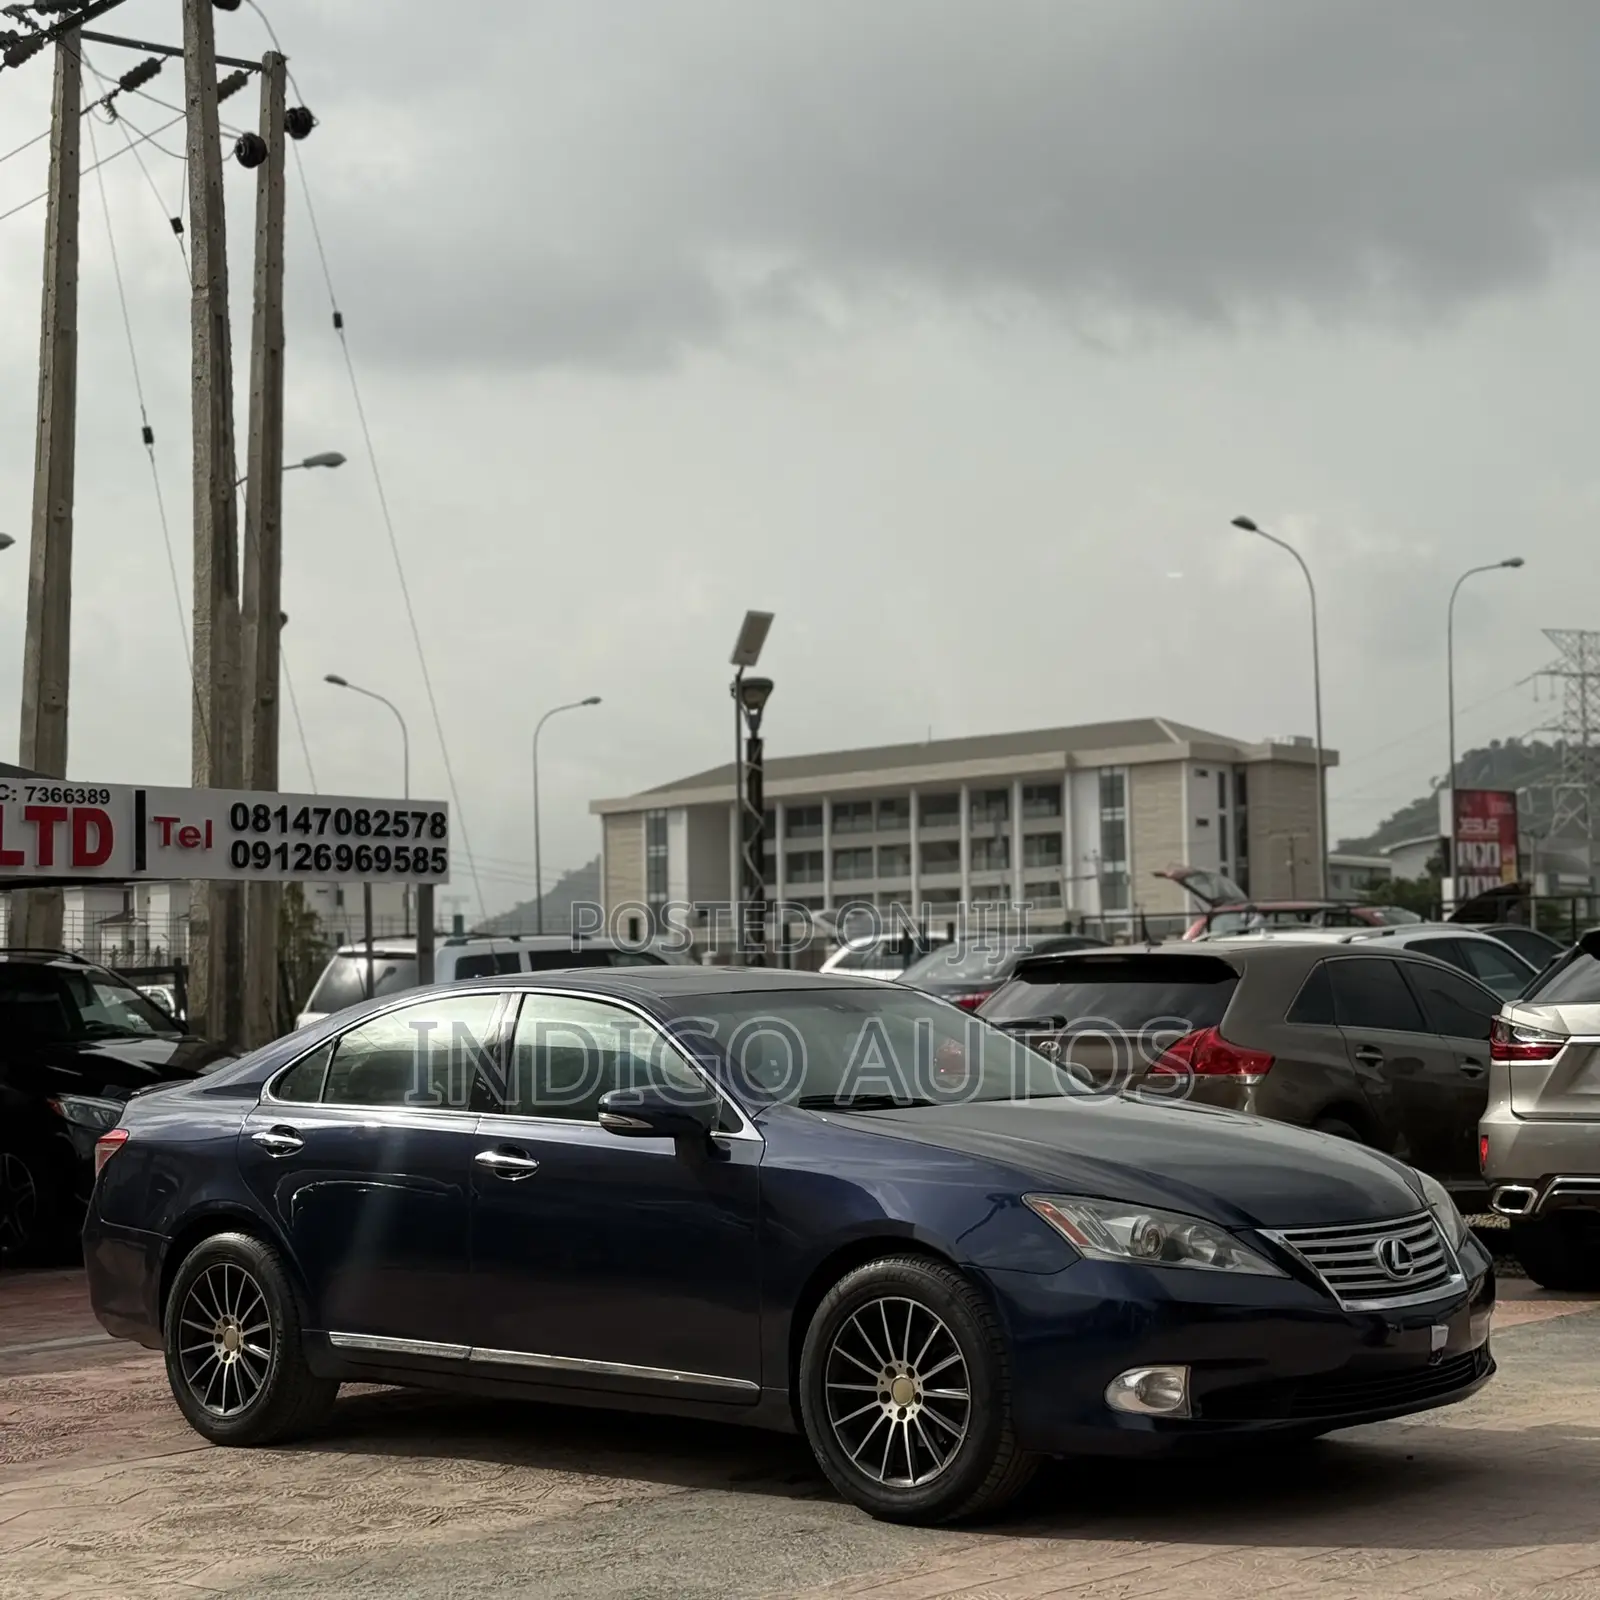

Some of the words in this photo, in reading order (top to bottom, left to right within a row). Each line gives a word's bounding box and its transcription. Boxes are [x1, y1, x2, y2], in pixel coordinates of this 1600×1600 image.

[24, 786, 111, 804] 7366389
[0, 804, 114, 866] LTD
[153, 816, 212, 848] Tel
[230, 802, 447, 839] 08147082578
[230, 840, 447, 873] 09126969585
